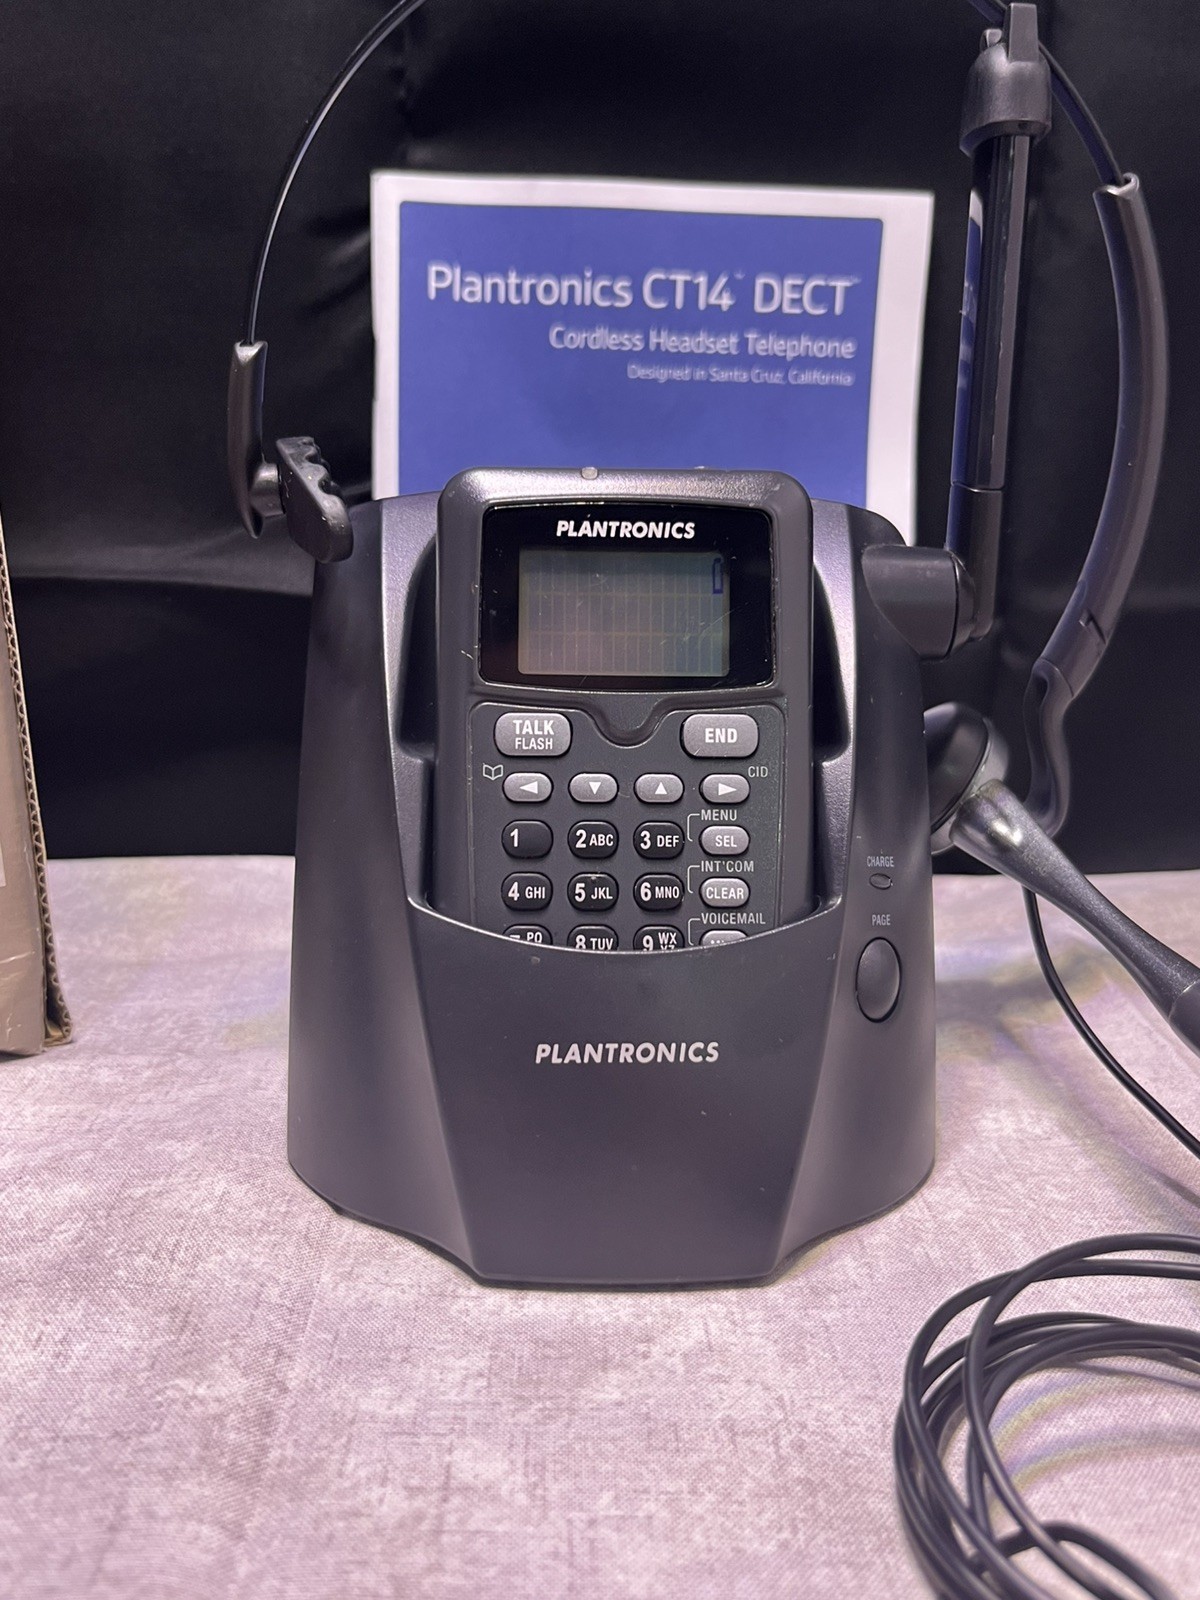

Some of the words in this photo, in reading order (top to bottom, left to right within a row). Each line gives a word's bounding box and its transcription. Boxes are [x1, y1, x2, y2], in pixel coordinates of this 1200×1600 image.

[427, 263, 633, 307] Plantronics
[549, 323, 645, 352] Cordless
[648, 327, 739, 355] Headset
[746, 332, 857, 361] Telephone
[627, 362, 692, 383] Designed
[693, 365, 707, 381] in
[708, 365, 750, 382] Santa
[788, 368, 855, 387] California
[556, 520, 696, 539] PLANTRONICS
[513, 719, 555, 735] TALK
[514, 737, 554, 750] FLASH
[704, 728, 738, 744] END
[748, 766, 769, 778] CID
[700, 809, 738, 821] MENU
[509, 829, 519, 847] 1
[575, 829, 587, 848] 2
[589, 833, 614, 847] ABC
[640, 830, 651, 848] 3
[656, 835, 680, 847] DEF
[714, 835, 738, 847] SEL
[700, 860, 755, 873] INT'COM
[866, 855, 895, 868] CHARGE
[508, 882, 520, 900] 4
[524, 886, 546, 899] GHI
[574, 883, 586, 902] 5
[591, 887, 614, 900] JKL
[640, 883, 652, 901] 6
[655, 887, 680, 899] MNO
[705, 887, 745, 900] CLEAR
[701, 912, 767, 925] VOICEMAIL
[871, 914, 891, 926] PAGE
[575, 934, 587, 949] 8
[590, 938, 614, 950] TUV
[642, 935, 654, 951] 9
[658, 932, 677, 945] WX
[535, 1041, 720, 1064] PLANTRONICS
